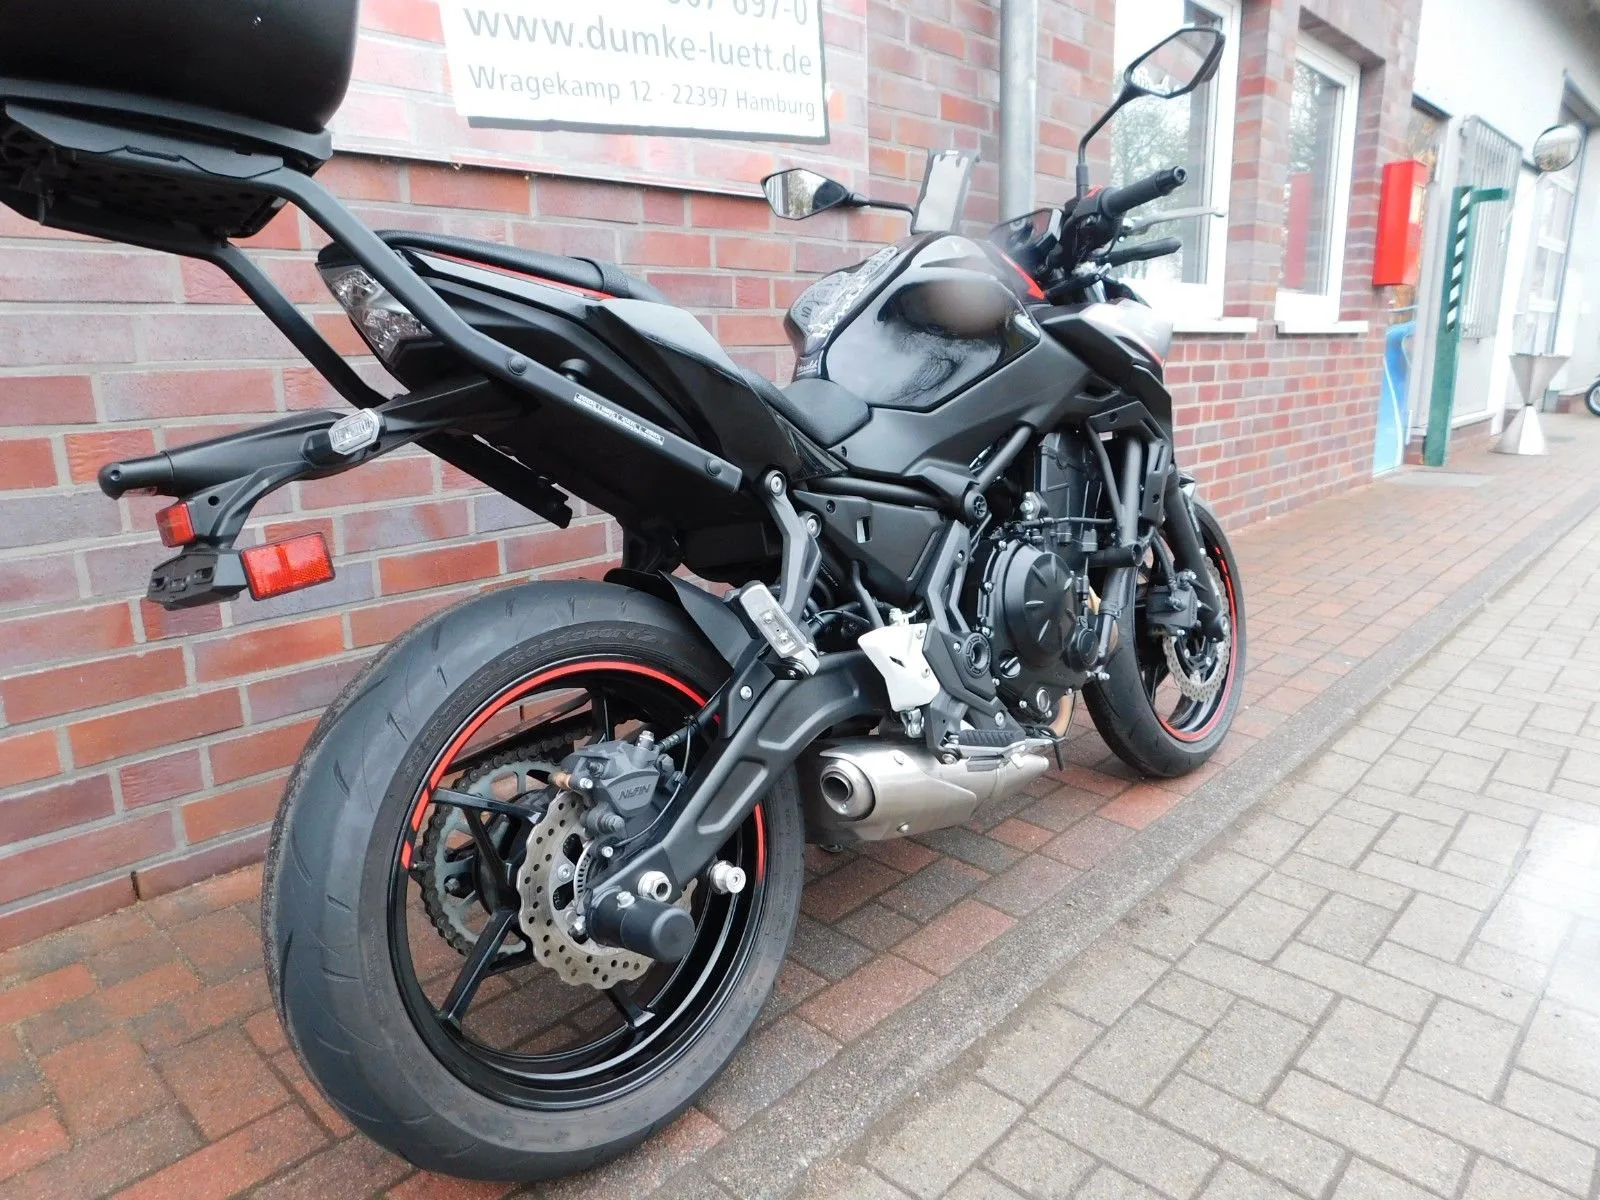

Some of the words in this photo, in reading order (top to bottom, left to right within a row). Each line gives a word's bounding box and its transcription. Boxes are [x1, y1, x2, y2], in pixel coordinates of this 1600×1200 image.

[462, 8, 813, 76] www.dumke-luett.de
[467, 64, 621, 105] Wragekamp
[629, 79, 653, 102] 12
[671, 83, 728, 111] 22397
[736, 89, 815, 122] Hamburg
